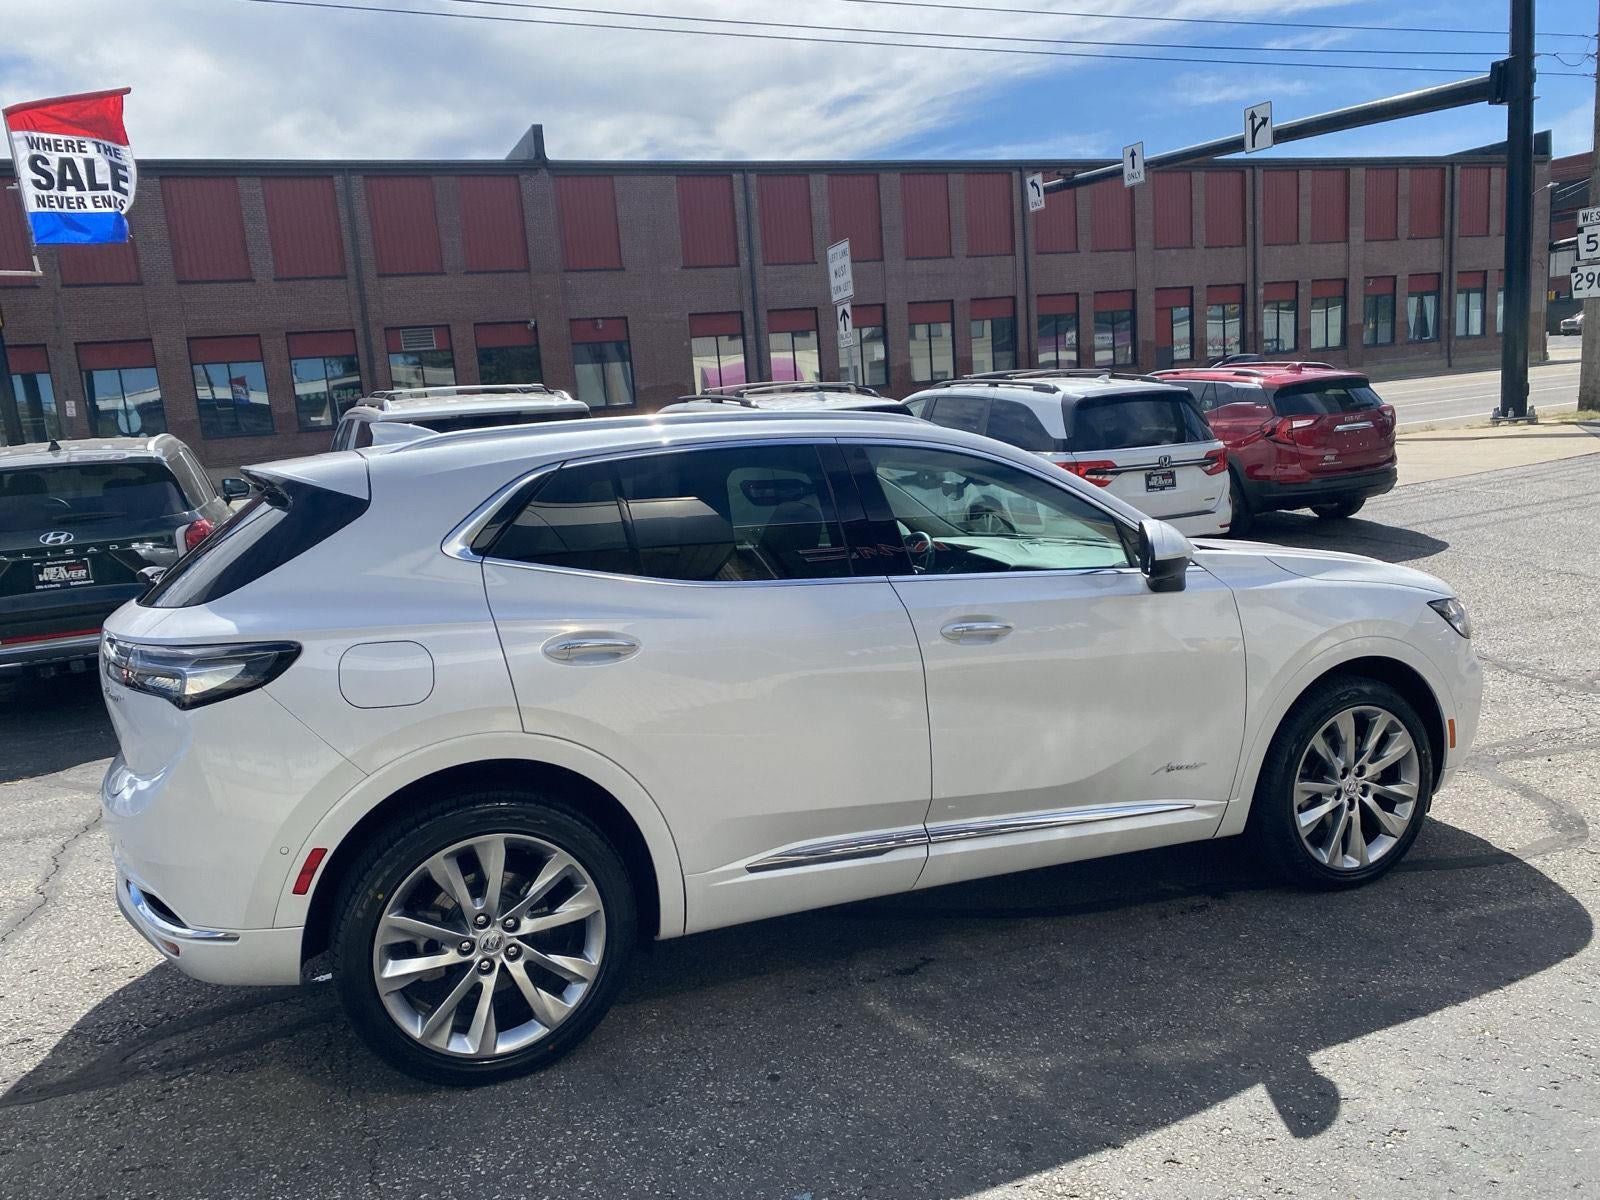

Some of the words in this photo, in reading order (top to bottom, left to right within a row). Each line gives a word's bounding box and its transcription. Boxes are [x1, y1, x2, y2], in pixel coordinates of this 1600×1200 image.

[25, 136, 88, 154] WHERE
[92, 141, 123, 161] THE
[28, 153, 129, 197] SALE
[1127, 170, 1141, 181] ONLY
[34, 194, 86, 210] NEVER
[1586, 233, 1598, 252] 5
[38, 569, 87, 582] WEAVER
